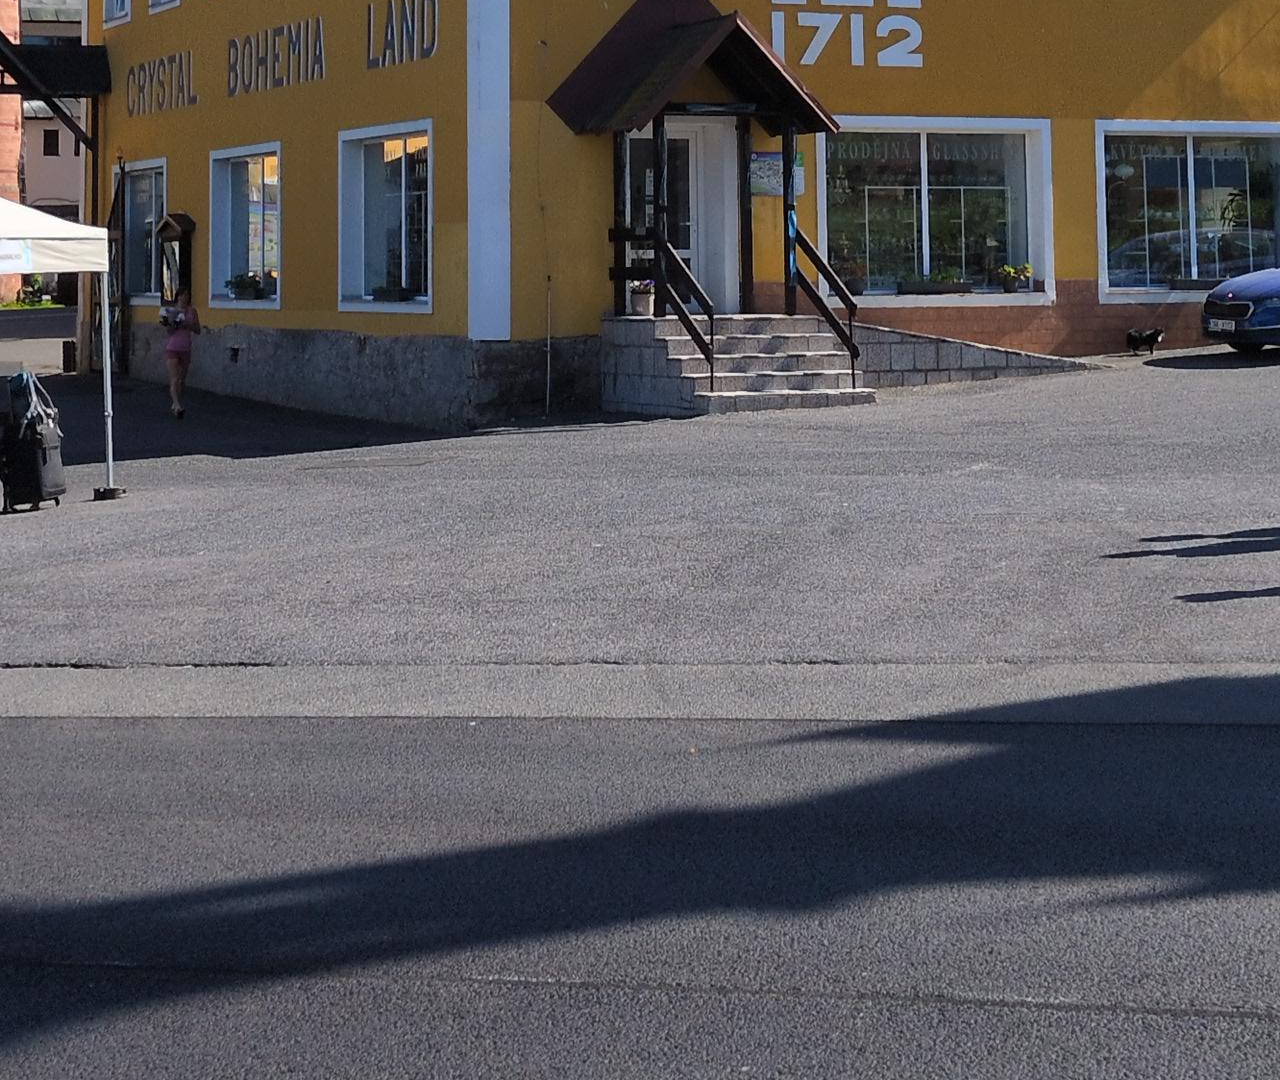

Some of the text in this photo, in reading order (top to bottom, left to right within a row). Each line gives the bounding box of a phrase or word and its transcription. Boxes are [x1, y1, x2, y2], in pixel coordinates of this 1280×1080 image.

[126, 50, 199, 117] CRYSTAL
[228, 17, 324, 97] BOHEMIA
[771, 11, 924, 68] 1712
